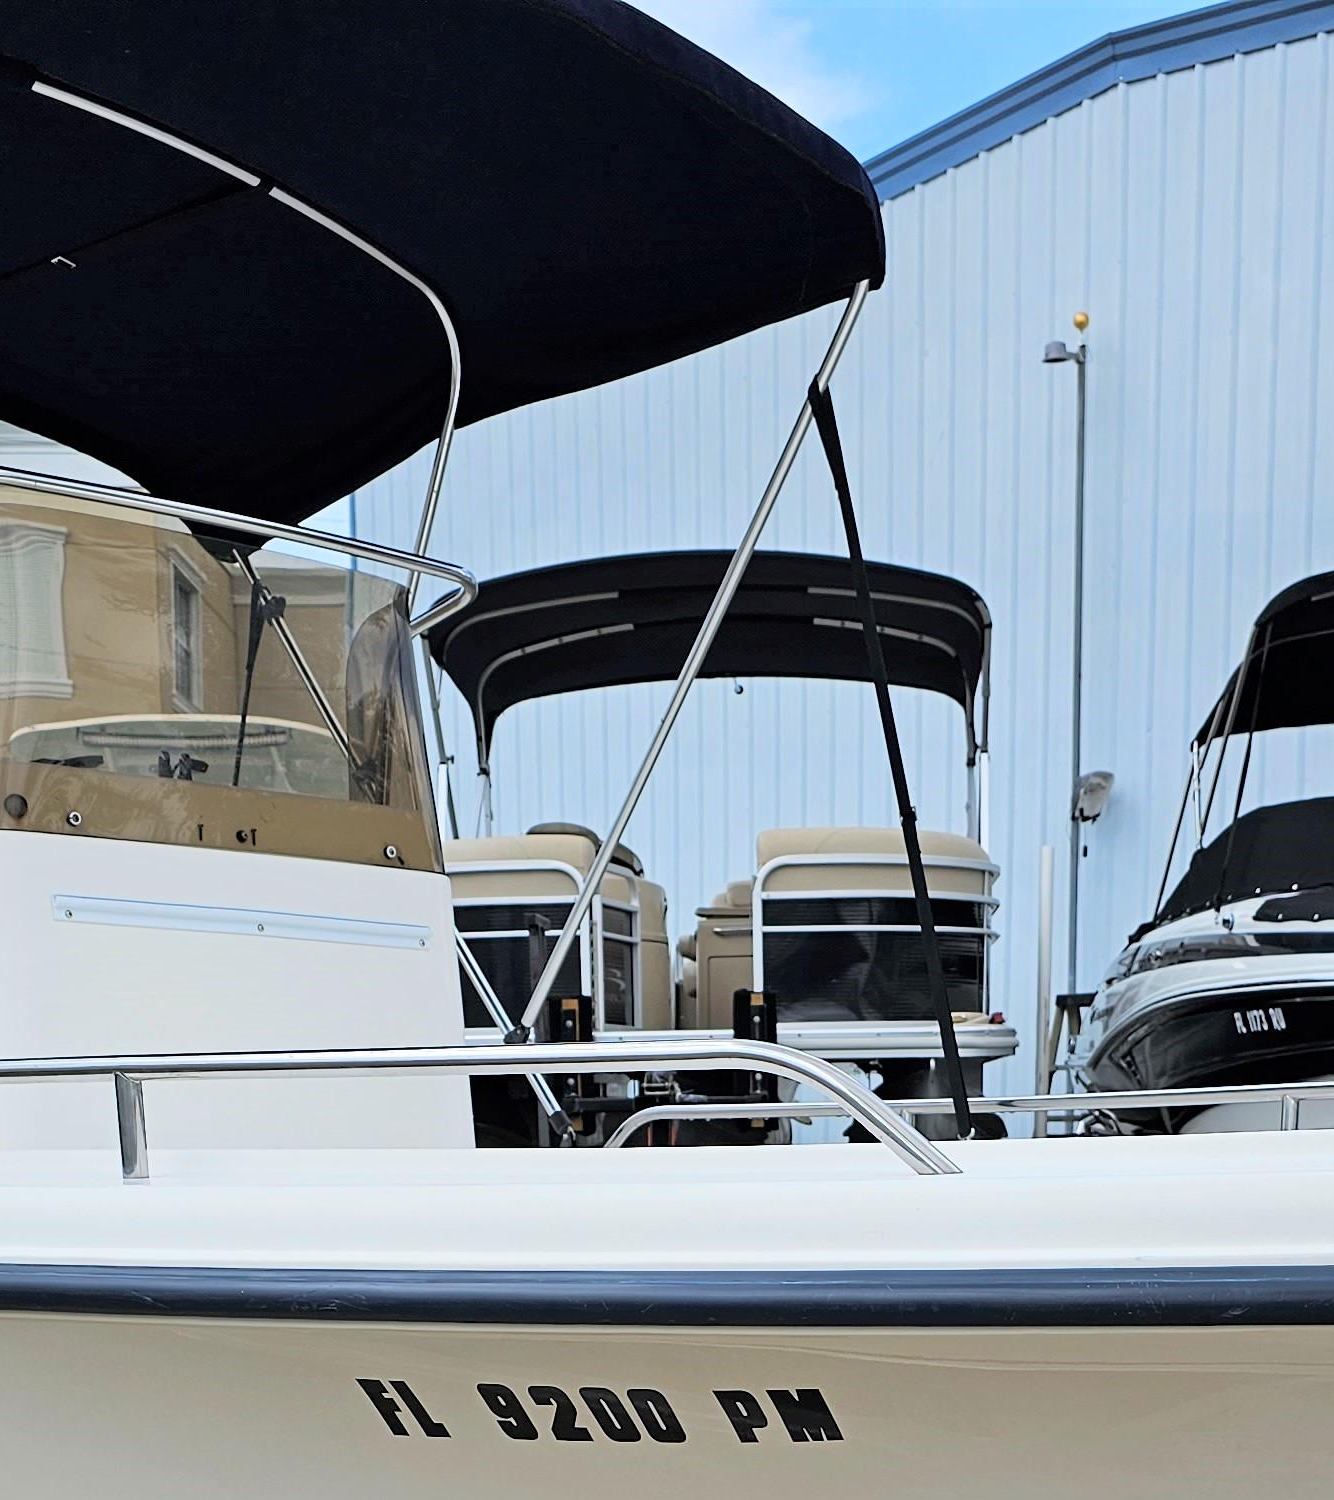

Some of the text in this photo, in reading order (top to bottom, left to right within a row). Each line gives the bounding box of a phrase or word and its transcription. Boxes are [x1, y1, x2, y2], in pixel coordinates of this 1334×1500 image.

[355, 1378, 845, 1444] FL 9200 PM
